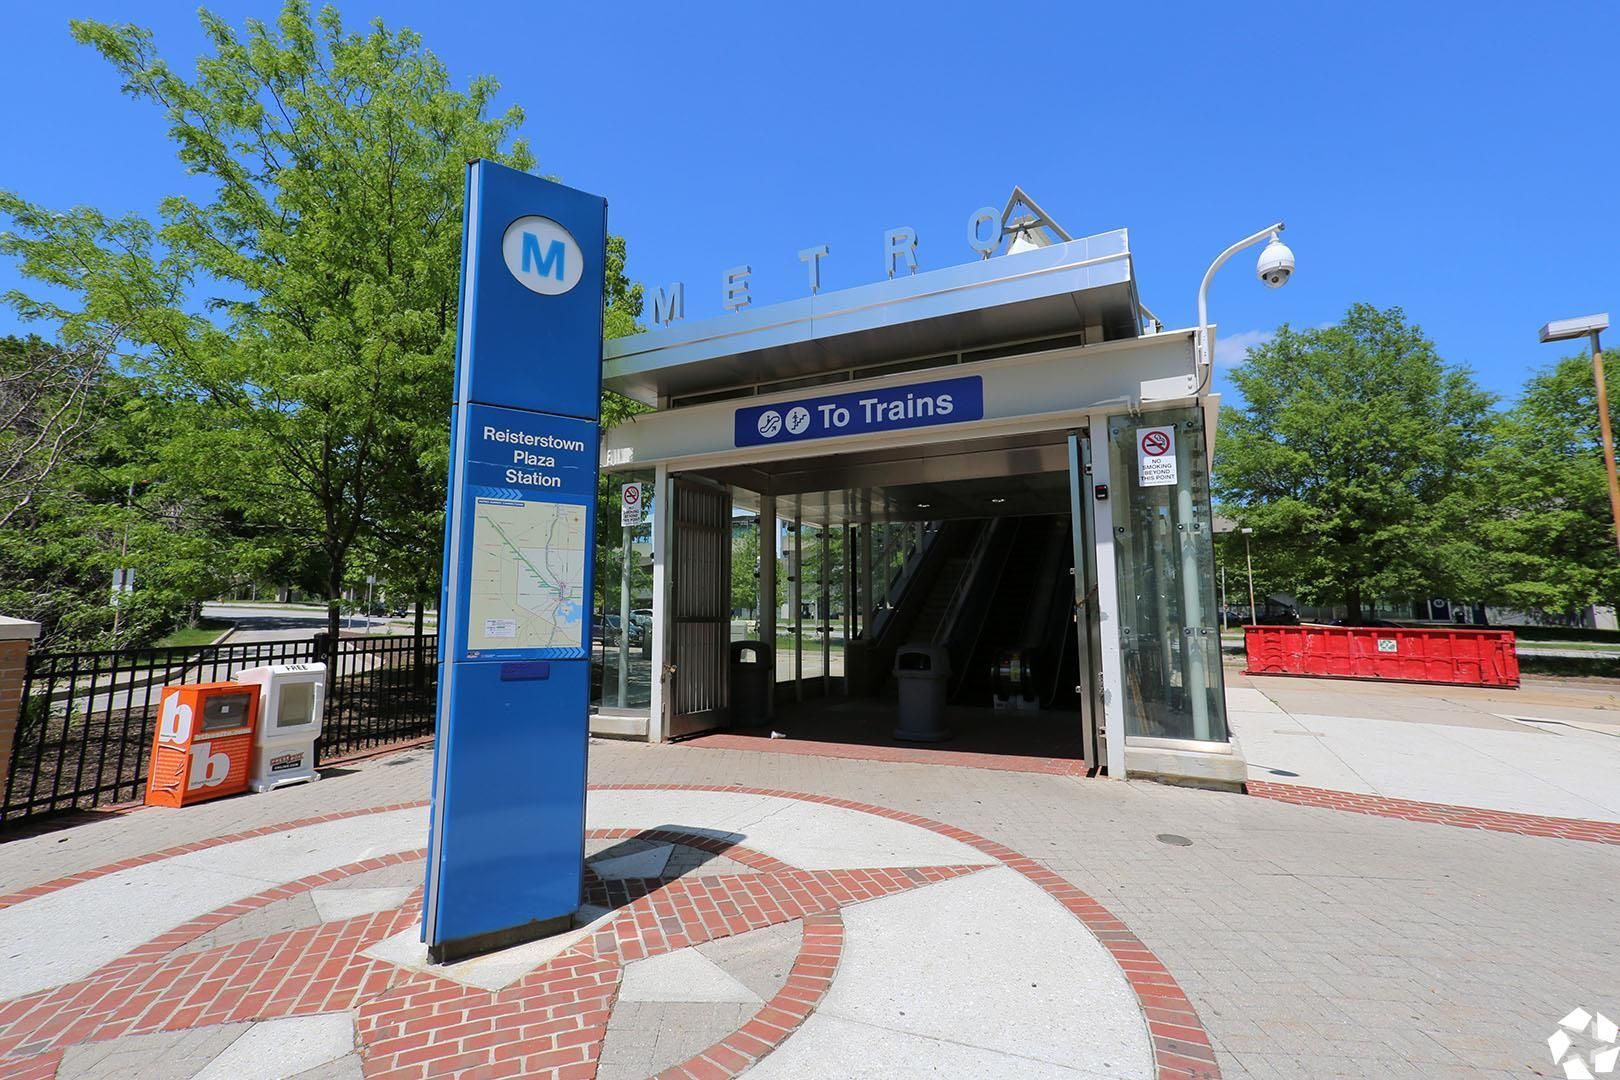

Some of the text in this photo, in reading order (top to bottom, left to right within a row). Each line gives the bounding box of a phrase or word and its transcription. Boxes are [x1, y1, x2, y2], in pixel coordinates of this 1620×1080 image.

[521, 231, 566, 281] M
[650, 206, 1002, 324] METRO
[818, 393, 954, 428] To Trains
[483, 426, 584, 452] Reisterstown
[513, 450, 555, 467] Plaza
[505, 468, 561, 487] Station
